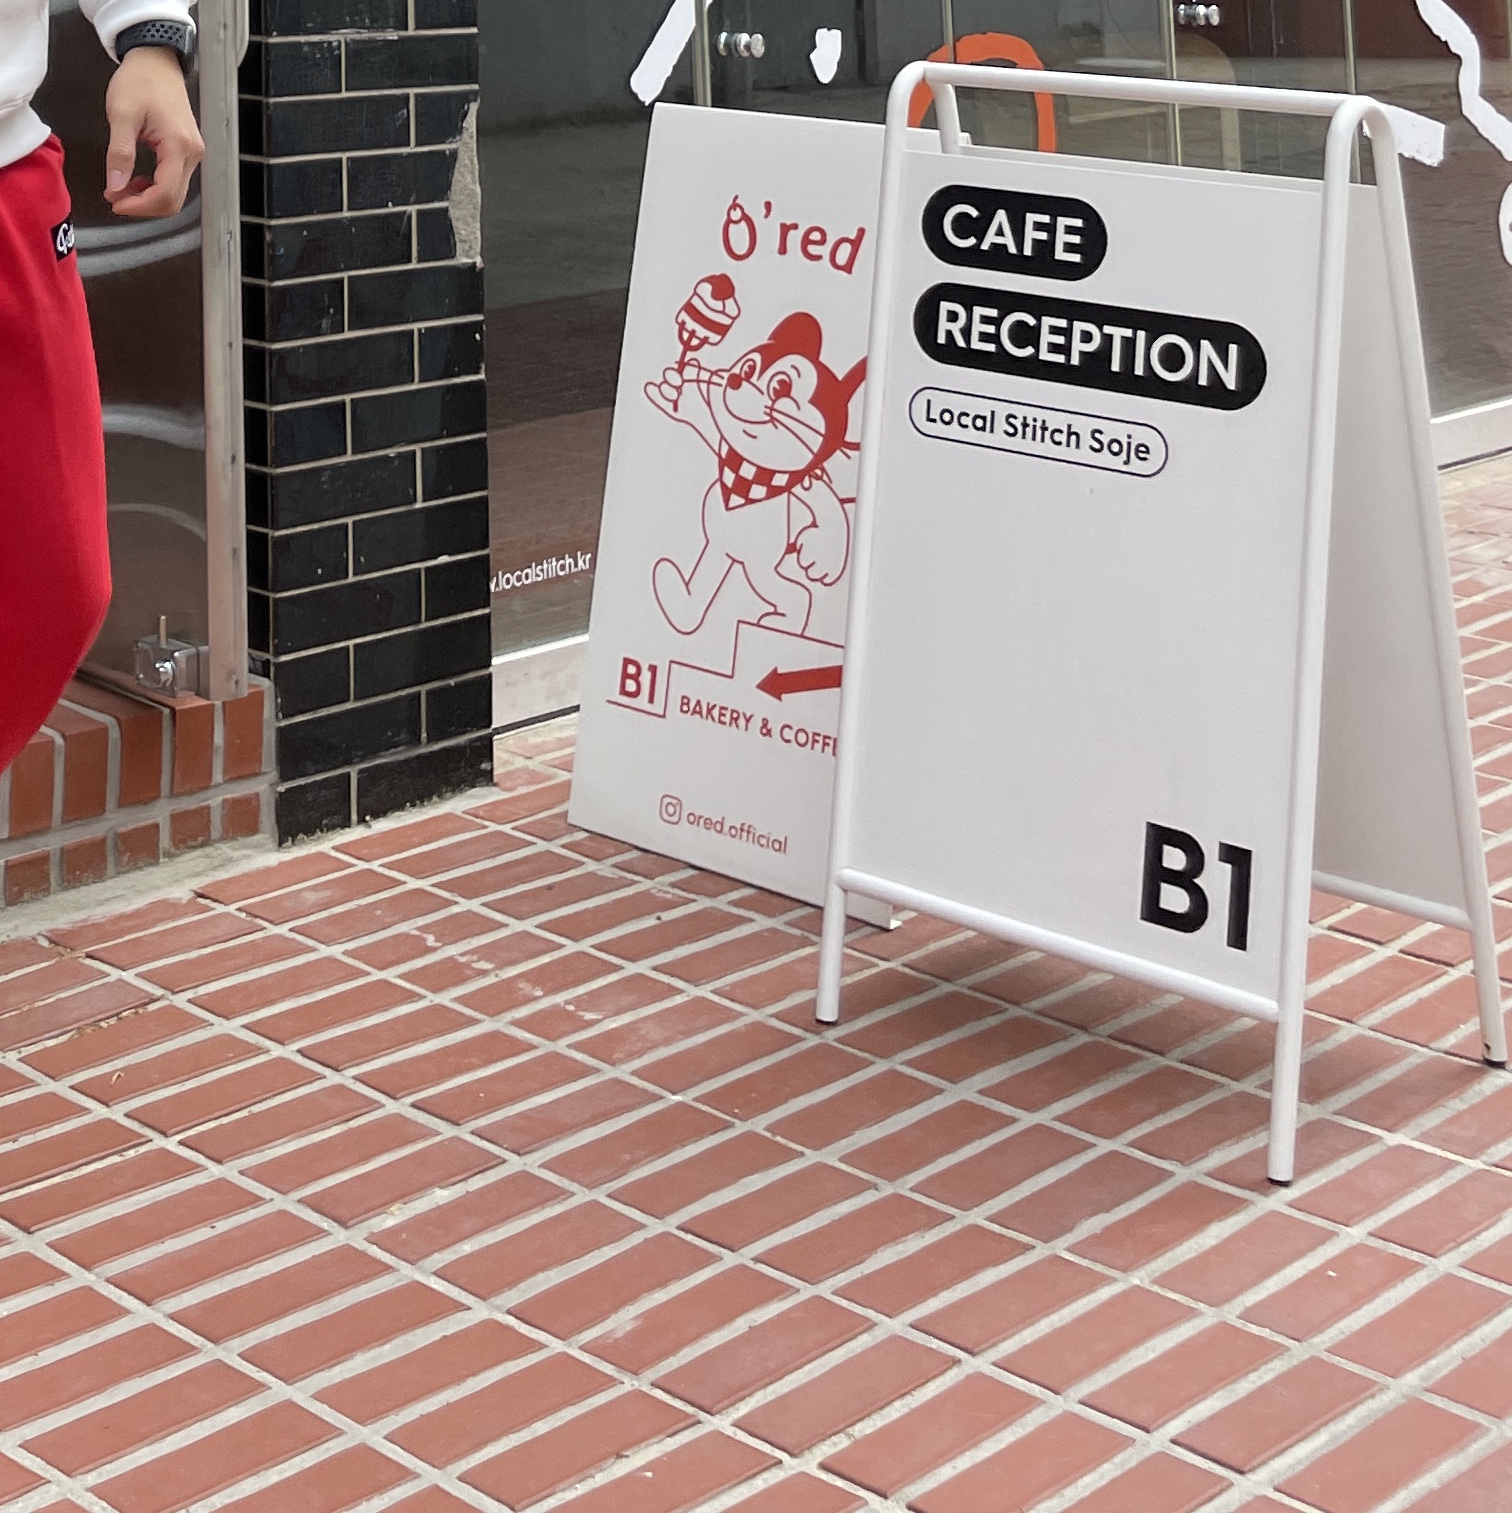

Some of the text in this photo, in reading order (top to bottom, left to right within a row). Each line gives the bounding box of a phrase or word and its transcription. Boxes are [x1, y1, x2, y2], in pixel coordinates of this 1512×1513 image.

[942, 203, 1084, 263] CAFE
[936, 300, 1239, 391] RECEPTION
[925, 398, 1151, 465] Local Stitch Soje
[618, 656, 658, 705] B1
[679, 694, 754, 732] BAKERY
[759, 717, 773, 738] &
[686, 808, 788, 855] ored.official
[1140, 821, 1253, 952] B1
